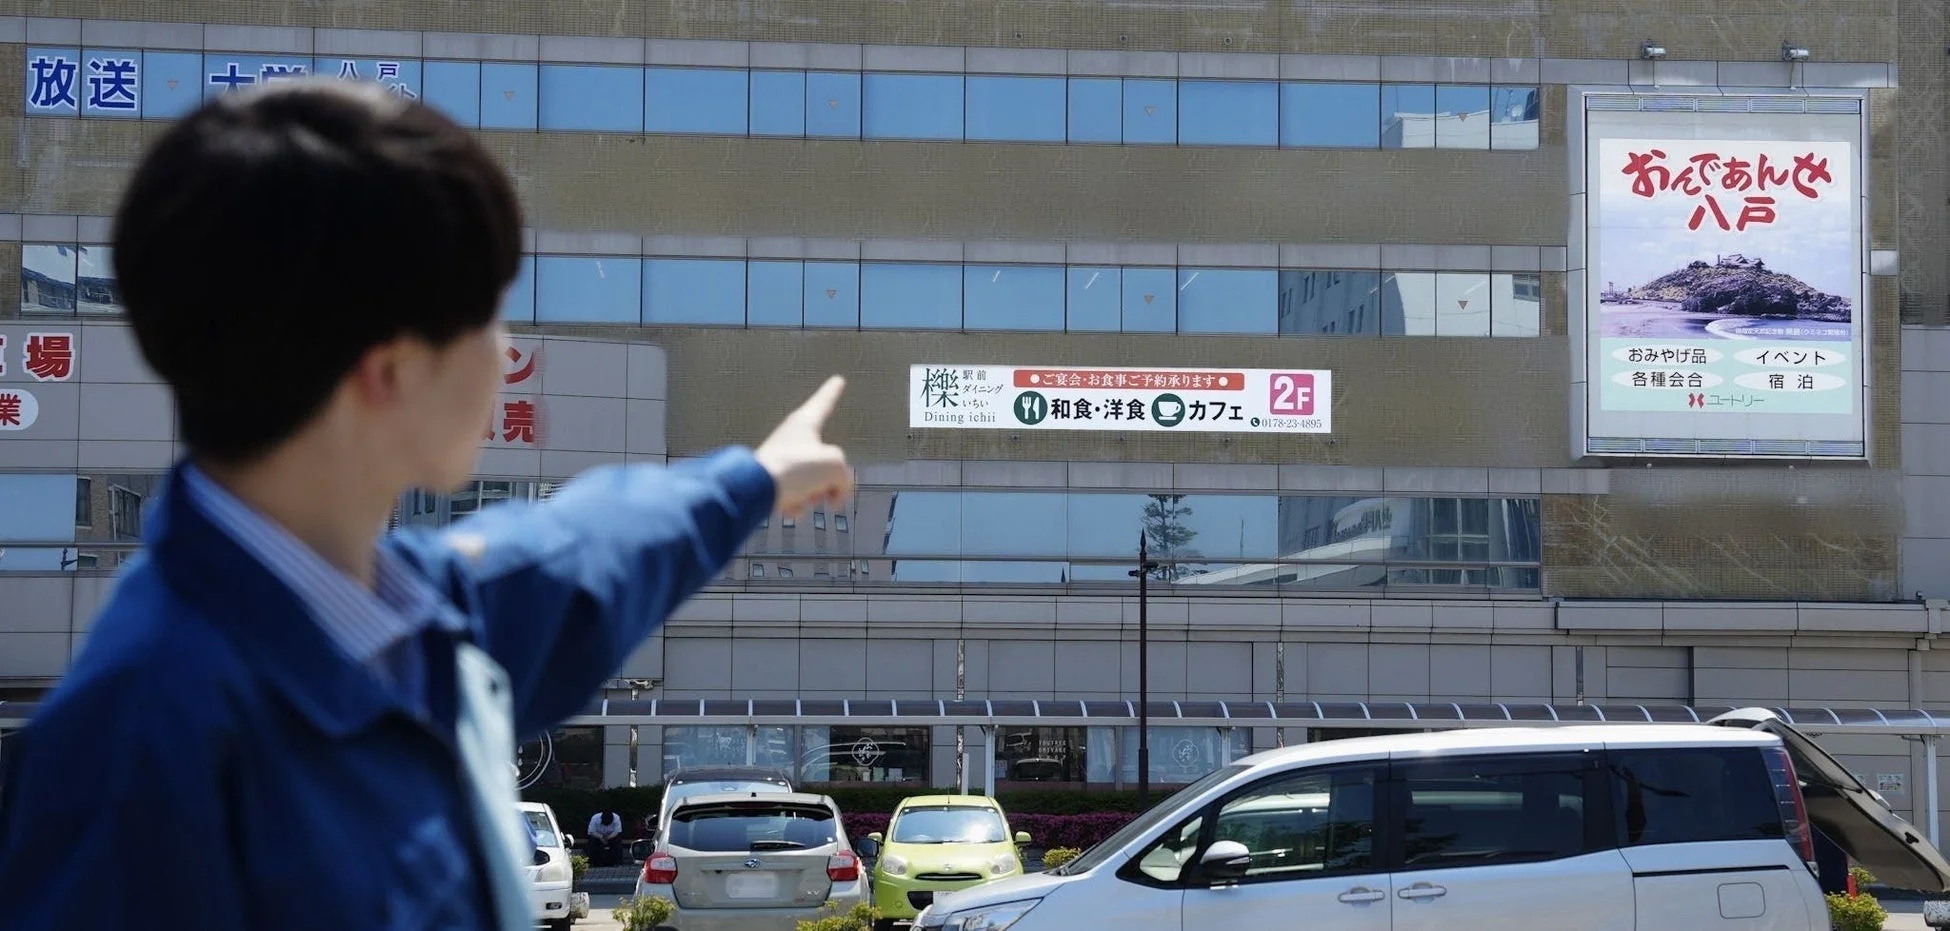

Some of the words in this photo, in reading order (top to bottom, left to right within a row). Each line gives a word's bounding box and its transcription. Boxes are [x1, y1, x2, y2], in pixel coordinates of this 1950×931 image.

[29, 57, 136, 109] 放送
[1688, 194, 1776, 231] 八戸
[0, 334, 72, 379] 場
[1628, 348, 1707, 365] おみやげ品
[1756, 350, 1826, 366] イベント
[963, 369, 987, 381] 駅前
[1631, 371, 1703, 388] 各種会合
[1768, 374, 1814, 390] 宿泊
[920, 368, 959, 408] 櫟
[963, 384, 1004, 395] ダイニング
[1273, 376, 1311, 411] 2F
[962, 399, 990, 409] いちい
[1051, 398, 1146, 421] 和食・洋食
[1188, 400, 1244, 421] カフェ
[1706, 394, 1765, 408] ユートリー
[924, 411, 965, 424] Dining
[969, 412, 996, 423] ichii
[1261, 418, 1322, 429] 0178-23-4895
